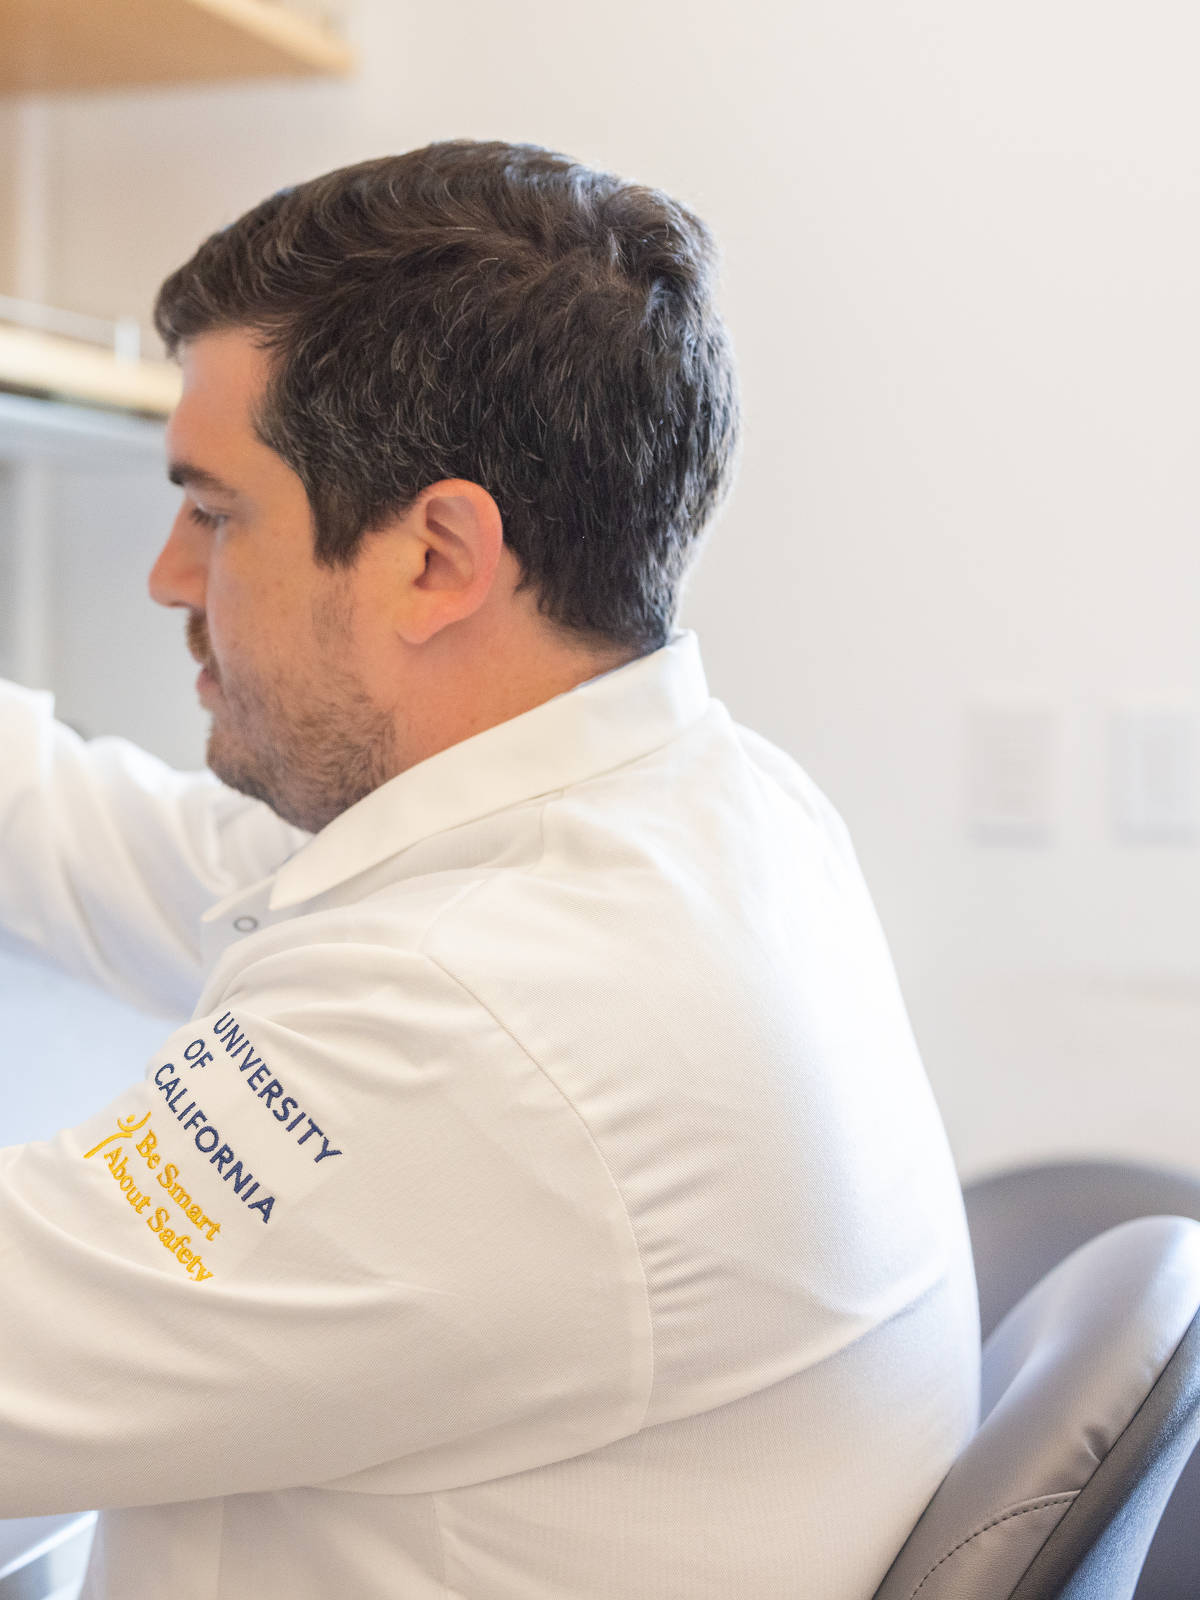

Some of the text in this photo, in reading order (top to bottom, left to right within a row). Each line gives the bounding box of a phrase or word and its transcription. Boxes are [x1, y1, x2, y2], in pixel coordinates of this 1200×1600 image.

[183, 1038, 214, 1069] OF
[213, 1011, 342, 1163] UNIVERSITY
[136, 1129, 221, 1241] Be Smart
[154, 1063, 276, 1224] CALIFORNIA
[103, 1146, 214, 1282] About Safety
